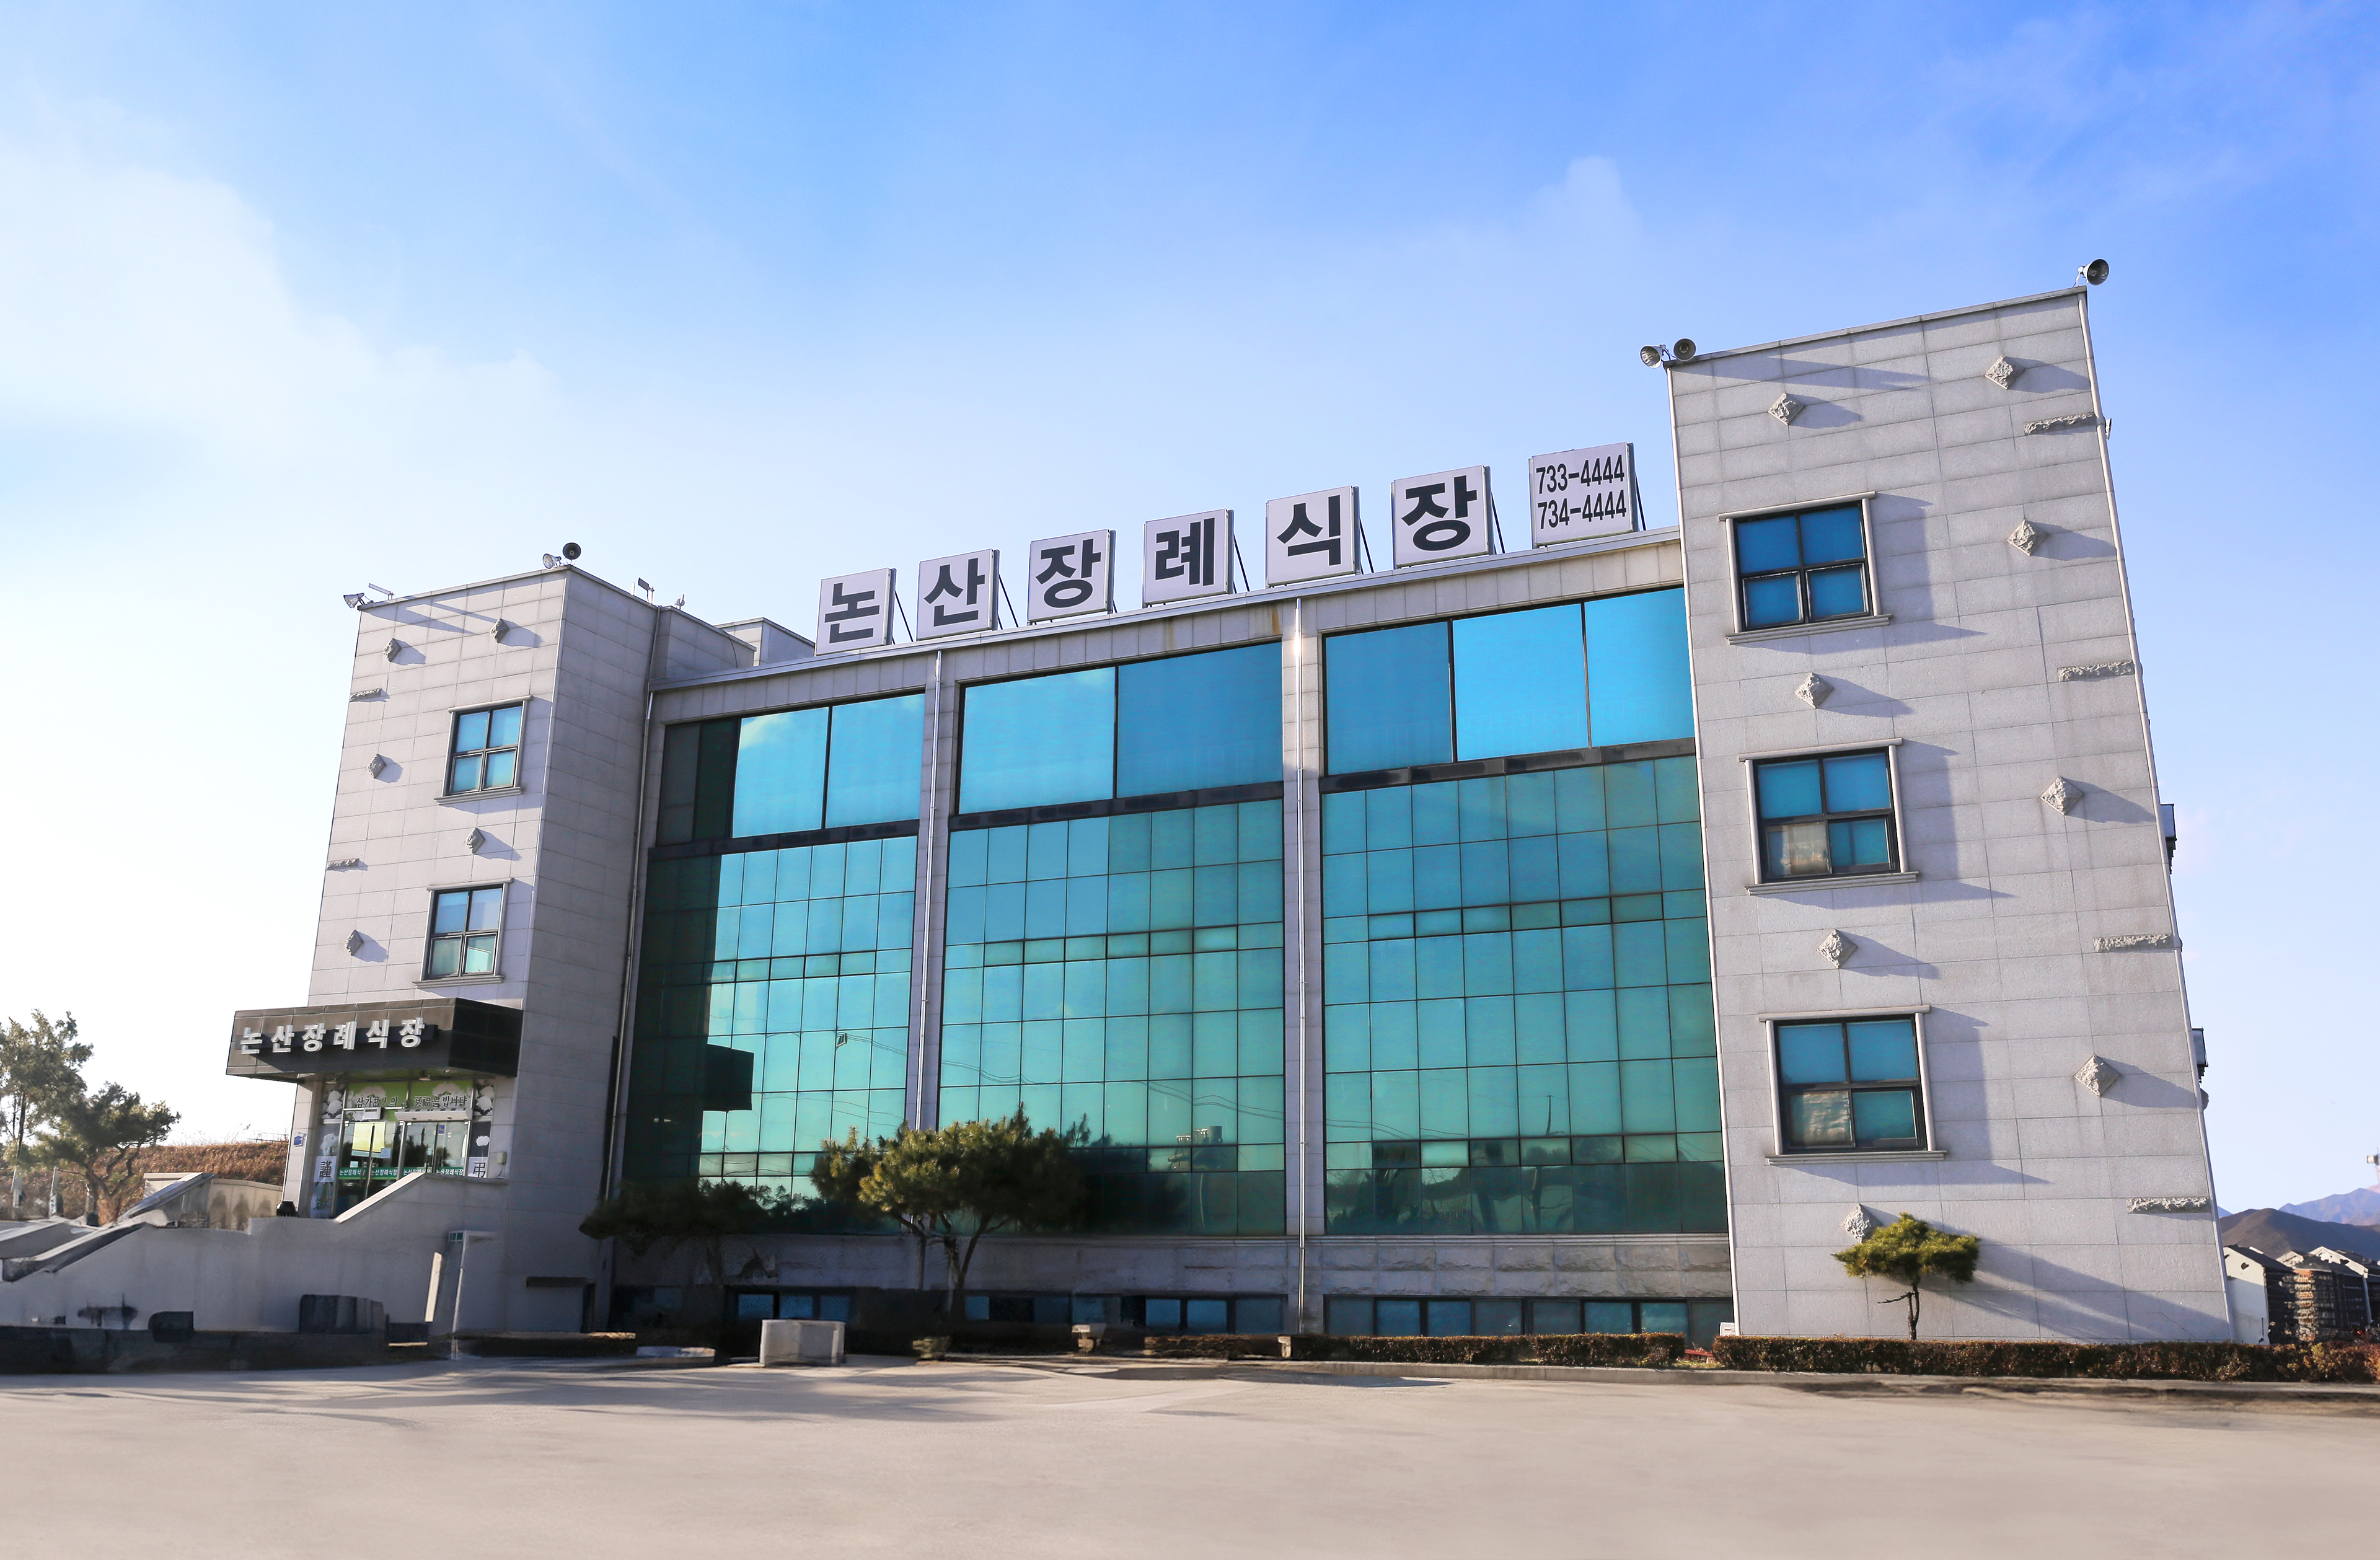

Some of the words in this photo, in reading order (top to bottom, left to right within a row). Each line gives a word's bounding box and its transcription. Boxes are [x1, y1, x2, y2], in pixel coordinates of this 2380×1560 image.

[1536, 454, 1624, 495] 733-4444
[1538, 489, 1627, 530] 734-4444
[240, 1016, 425, 1055] 논산장례식장
[443, 1095, 467, 1107] 빕니다
